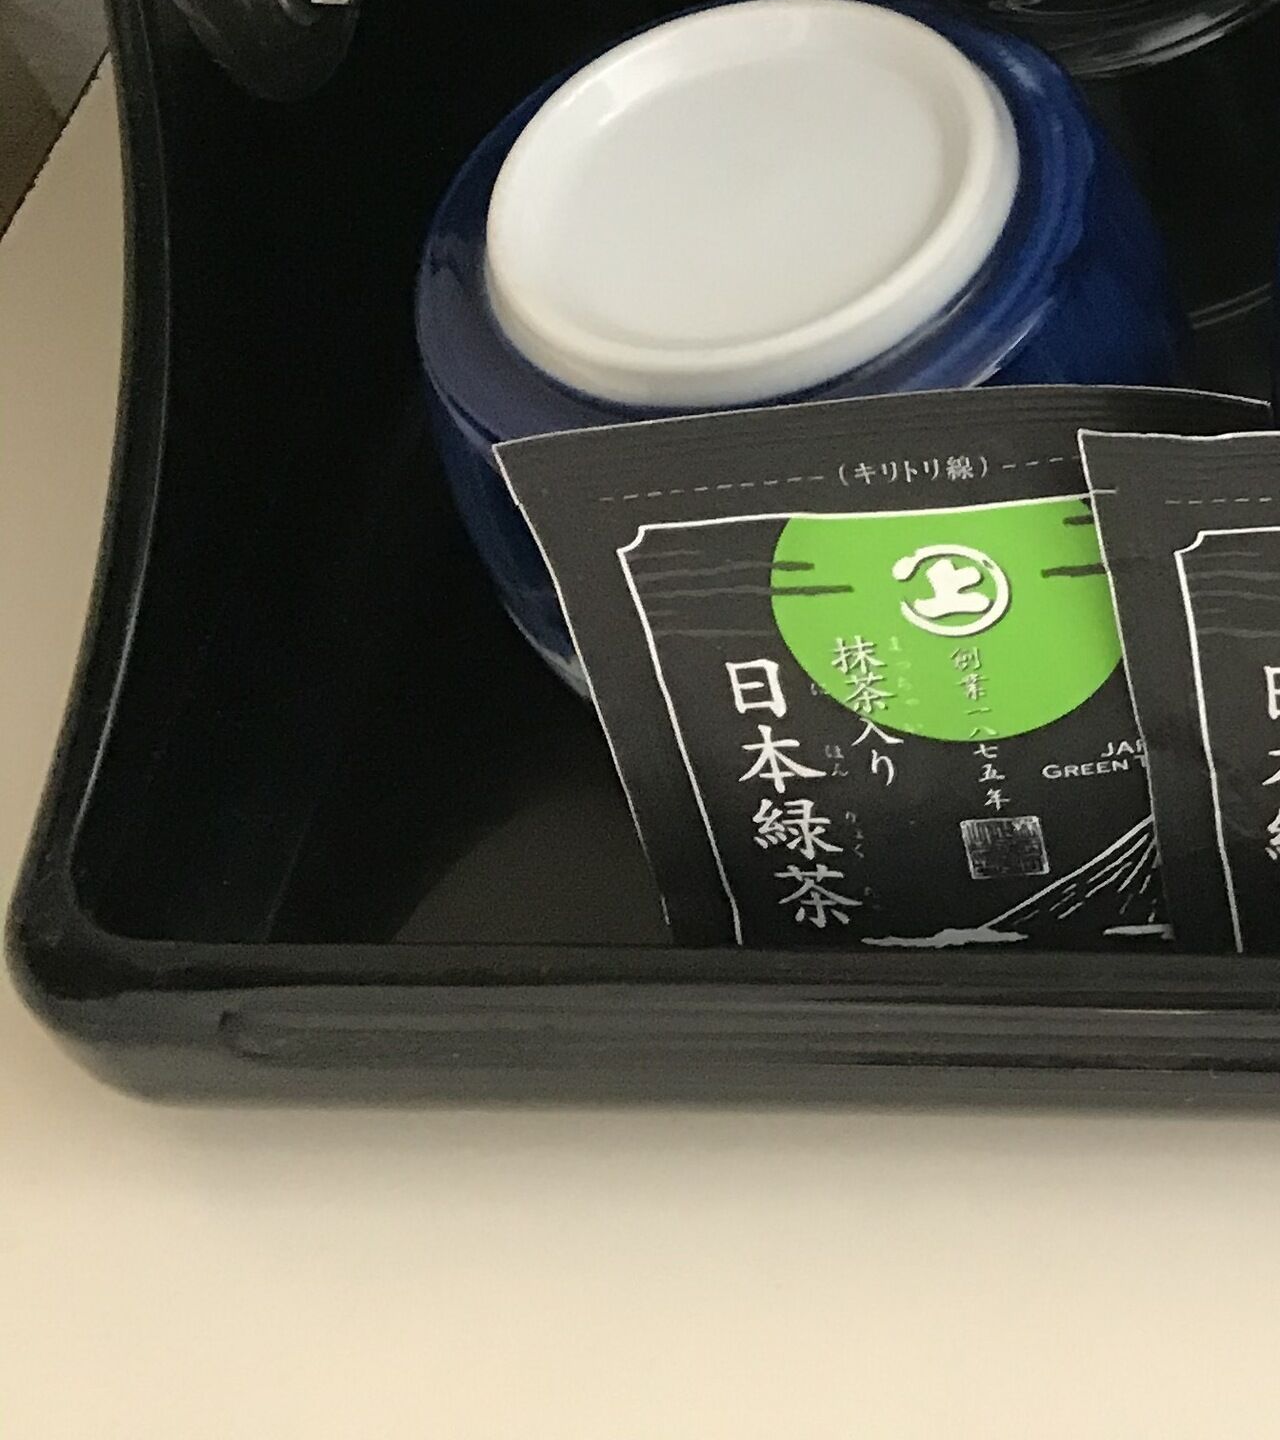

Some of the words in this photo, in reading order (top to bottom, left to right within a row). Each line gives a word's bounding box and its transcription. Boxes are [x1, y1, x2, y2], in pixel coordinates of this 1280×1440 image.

[725, 658, 864, 929] 日本緑茶
[830, 634, 905, 787] 抹茶入り
